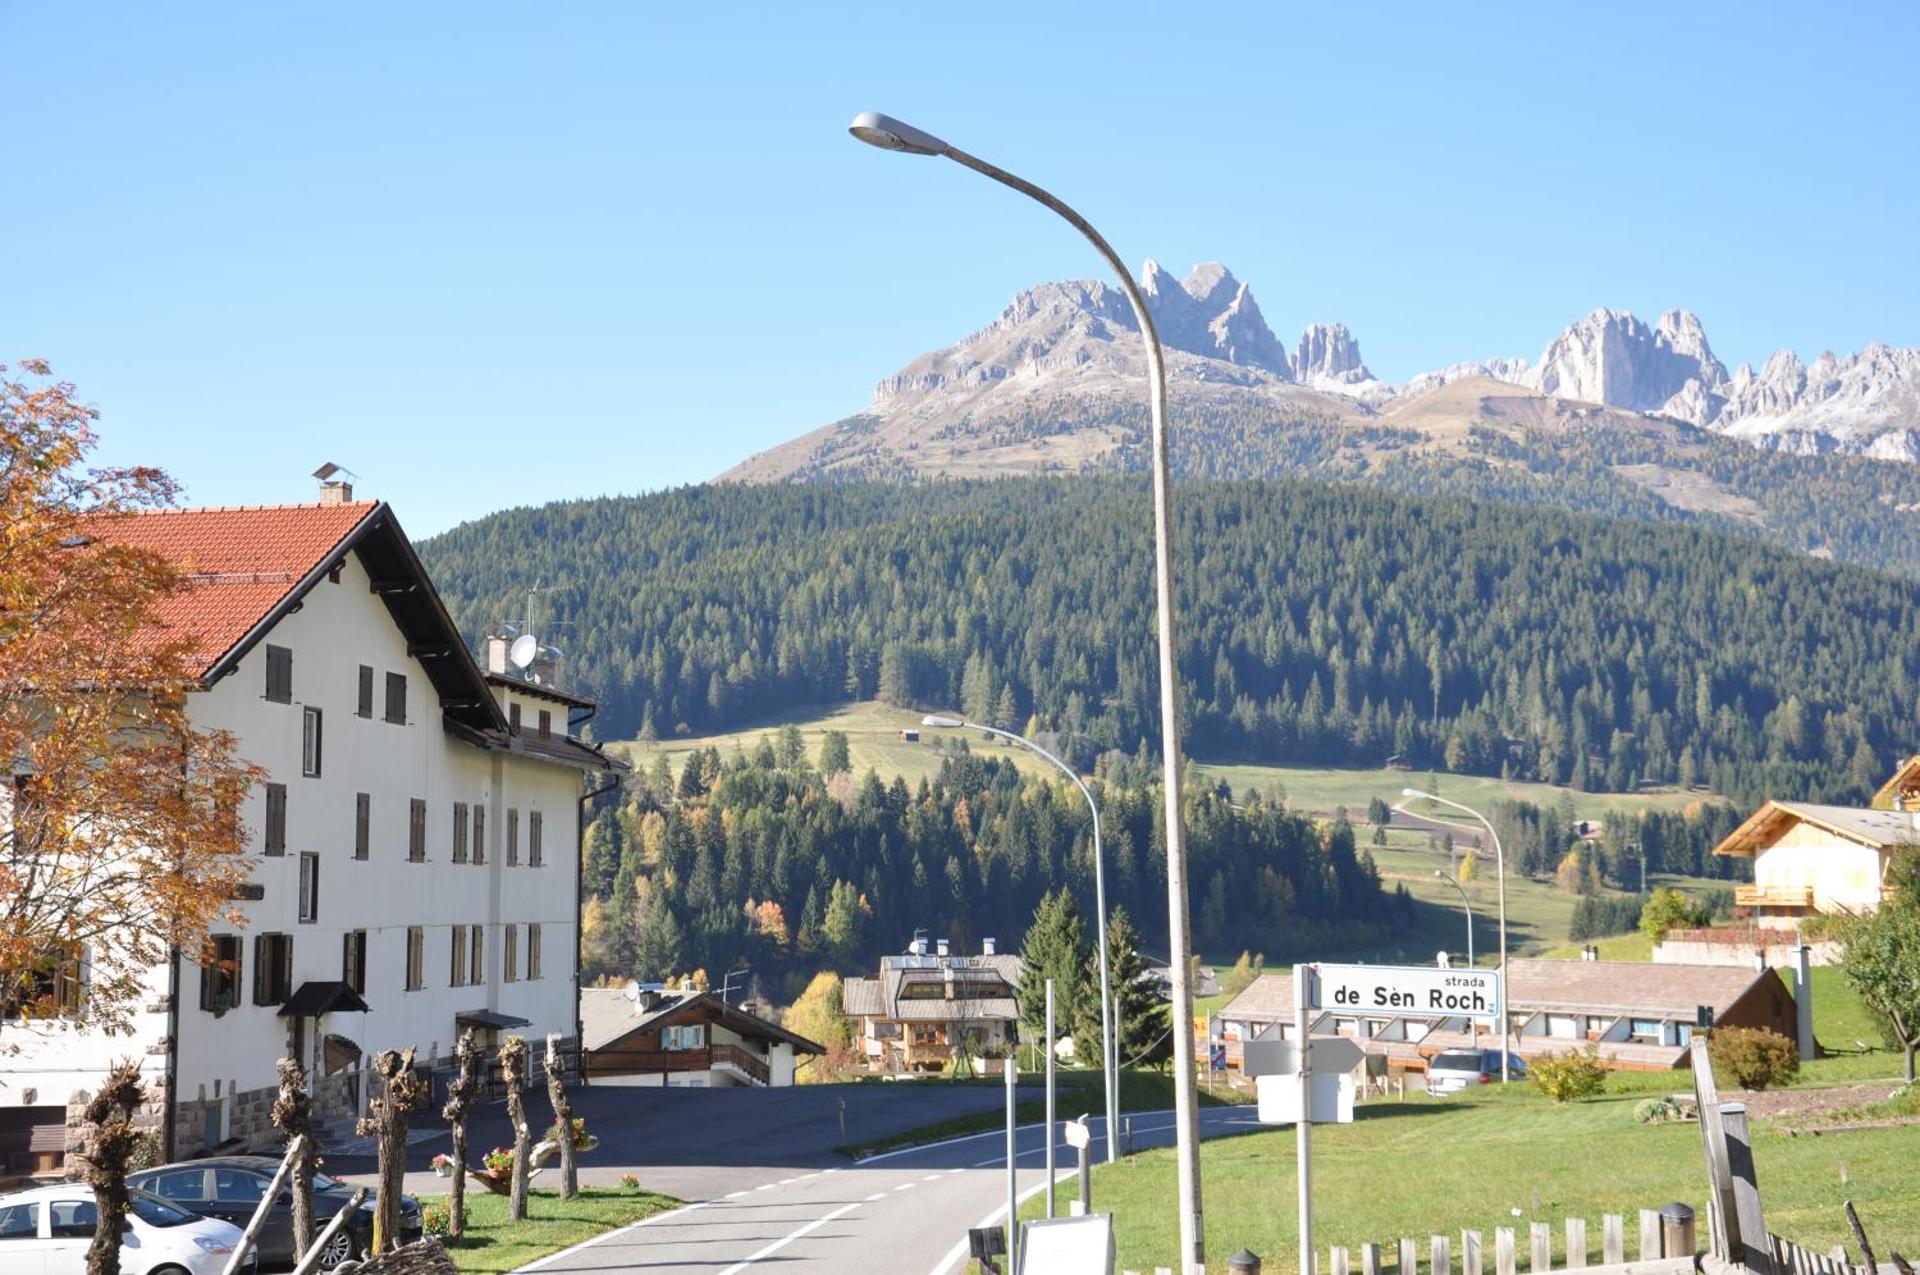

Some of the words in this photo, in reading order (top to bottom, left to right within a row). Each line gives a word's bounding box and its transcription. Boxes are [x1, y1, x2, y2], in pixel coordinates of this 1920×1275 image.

[1445, 976, 1485, 988] strada
[1334, 985, 1360, 1005] de
[1373, 986, 1415, 1007] Sèn
[1429, 989, 1485, 1011] Roch
